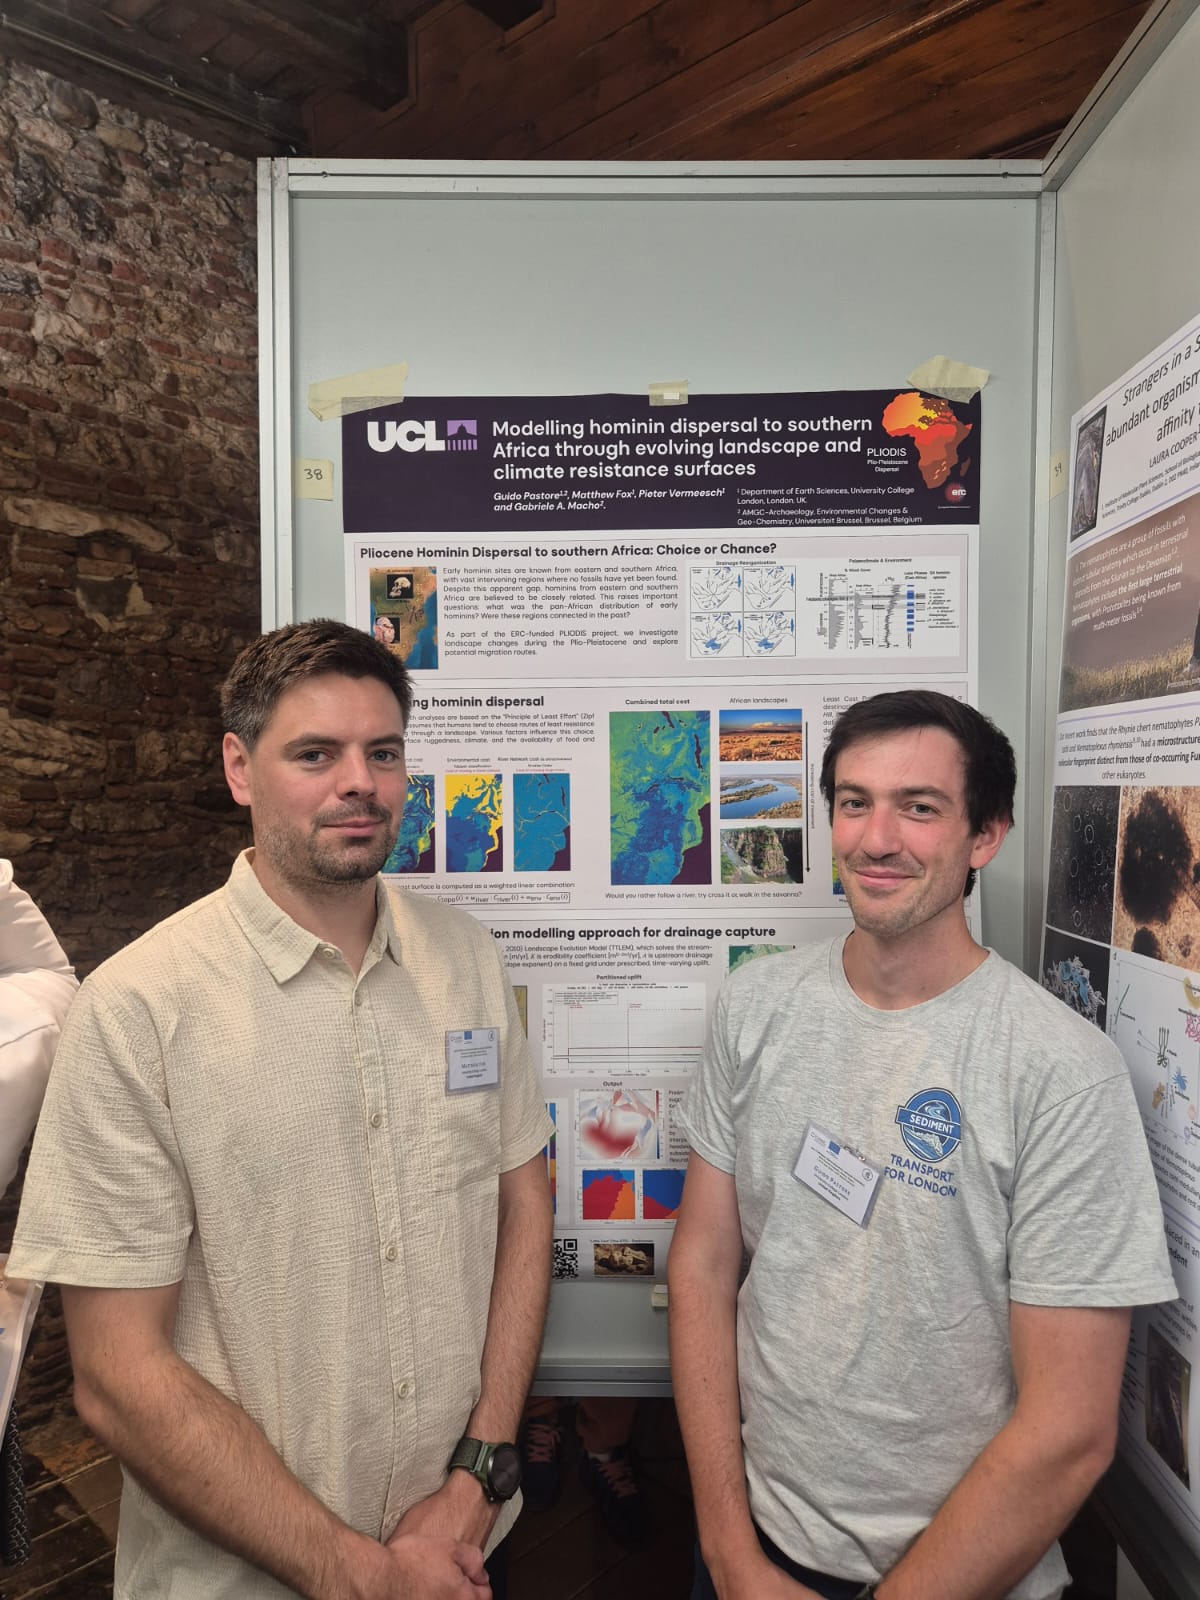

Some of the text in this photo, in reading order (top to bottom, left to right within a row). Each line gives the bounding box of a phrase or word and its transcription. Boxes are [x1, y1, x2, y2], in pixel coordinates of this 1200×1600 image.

[1122, 345, 1191, 406] Strangers in a
[492, 416, 873, 440] Modelling hominin dispersal to southern
[1106, 404, 1150, 446] abundant
[1156, 406, 1195, 442] affinity
[367, 420, 446, 452] UCL
[492, 437, 862, 460] Africa through evolving landscape and
[866, 448, 907, 456] PLIODIS
[1150, 432, 1198, 468] LAURA COOPER
[304, 468, 323, 480] 38
[493, 460, 756, 480] climate resistance surfaces
[493, 489, 522, 500] Guido
[571, 488, 614, 499] Matthew
[638, 488, 666, 498] Pieter
[740, 487, 784, 497] Department
[785, 487, 793, 495] of
[794, 486, 815, 495] Earth
[850, 486, 886, 496] University
[886, 485, 915, 495] College
[493, 500, 512, 511] and
[514, 500, 554, 511] Gabriele
[556, 500, 566, 510] A.
[736, 495, 808, 506] London, London, UK
[816, 506, 868, 515] Environmental
[868, 506, 901, 516] Changes
[902, 506, 909, 514] &
[1172, 515, 1186, 528] with
[360, 541, 777, 560] Pliocene Hominin Dispersal to southern Africa: Choice or Chance?
[442, 566, 461, 575] Early
[1154, 562, 1183, 582] terrestrial
[476, 575, 517, 584] intervening
[518, 575, 544, 584] regions
[622, 574, 634, 583] yet
[443, 585, 470, 594] Despite
[489, 584, 523, 593] apparent
[540, 593, 566, 602] closely
[642, 592, 679, 601] important
[549, 602, 593, 611] pan-African
[659, 601, 679, 610] early
[521, 612, 548, 620] regions
[609, 611, 632, 620] past?
[431, 695, 482, 707] hominin
[485, 694, 545, 709] dispersal
[752, 696, 789, 705] landscapes
[512, 927, 575, 941] modelling
[578, 926, 640, 941] approach
[642, 926, 660, 938] for
[664, 926, 722, 940] drainage
[725, 926, 777, 940] capture
[910, 1114, 954, 1134] SEDIMENT
[890, 1153, 954, 1182] TRANSPORT
[884, 1166, 905, 1182] FOR
[908, 1174, 957, 1197] LONDON
